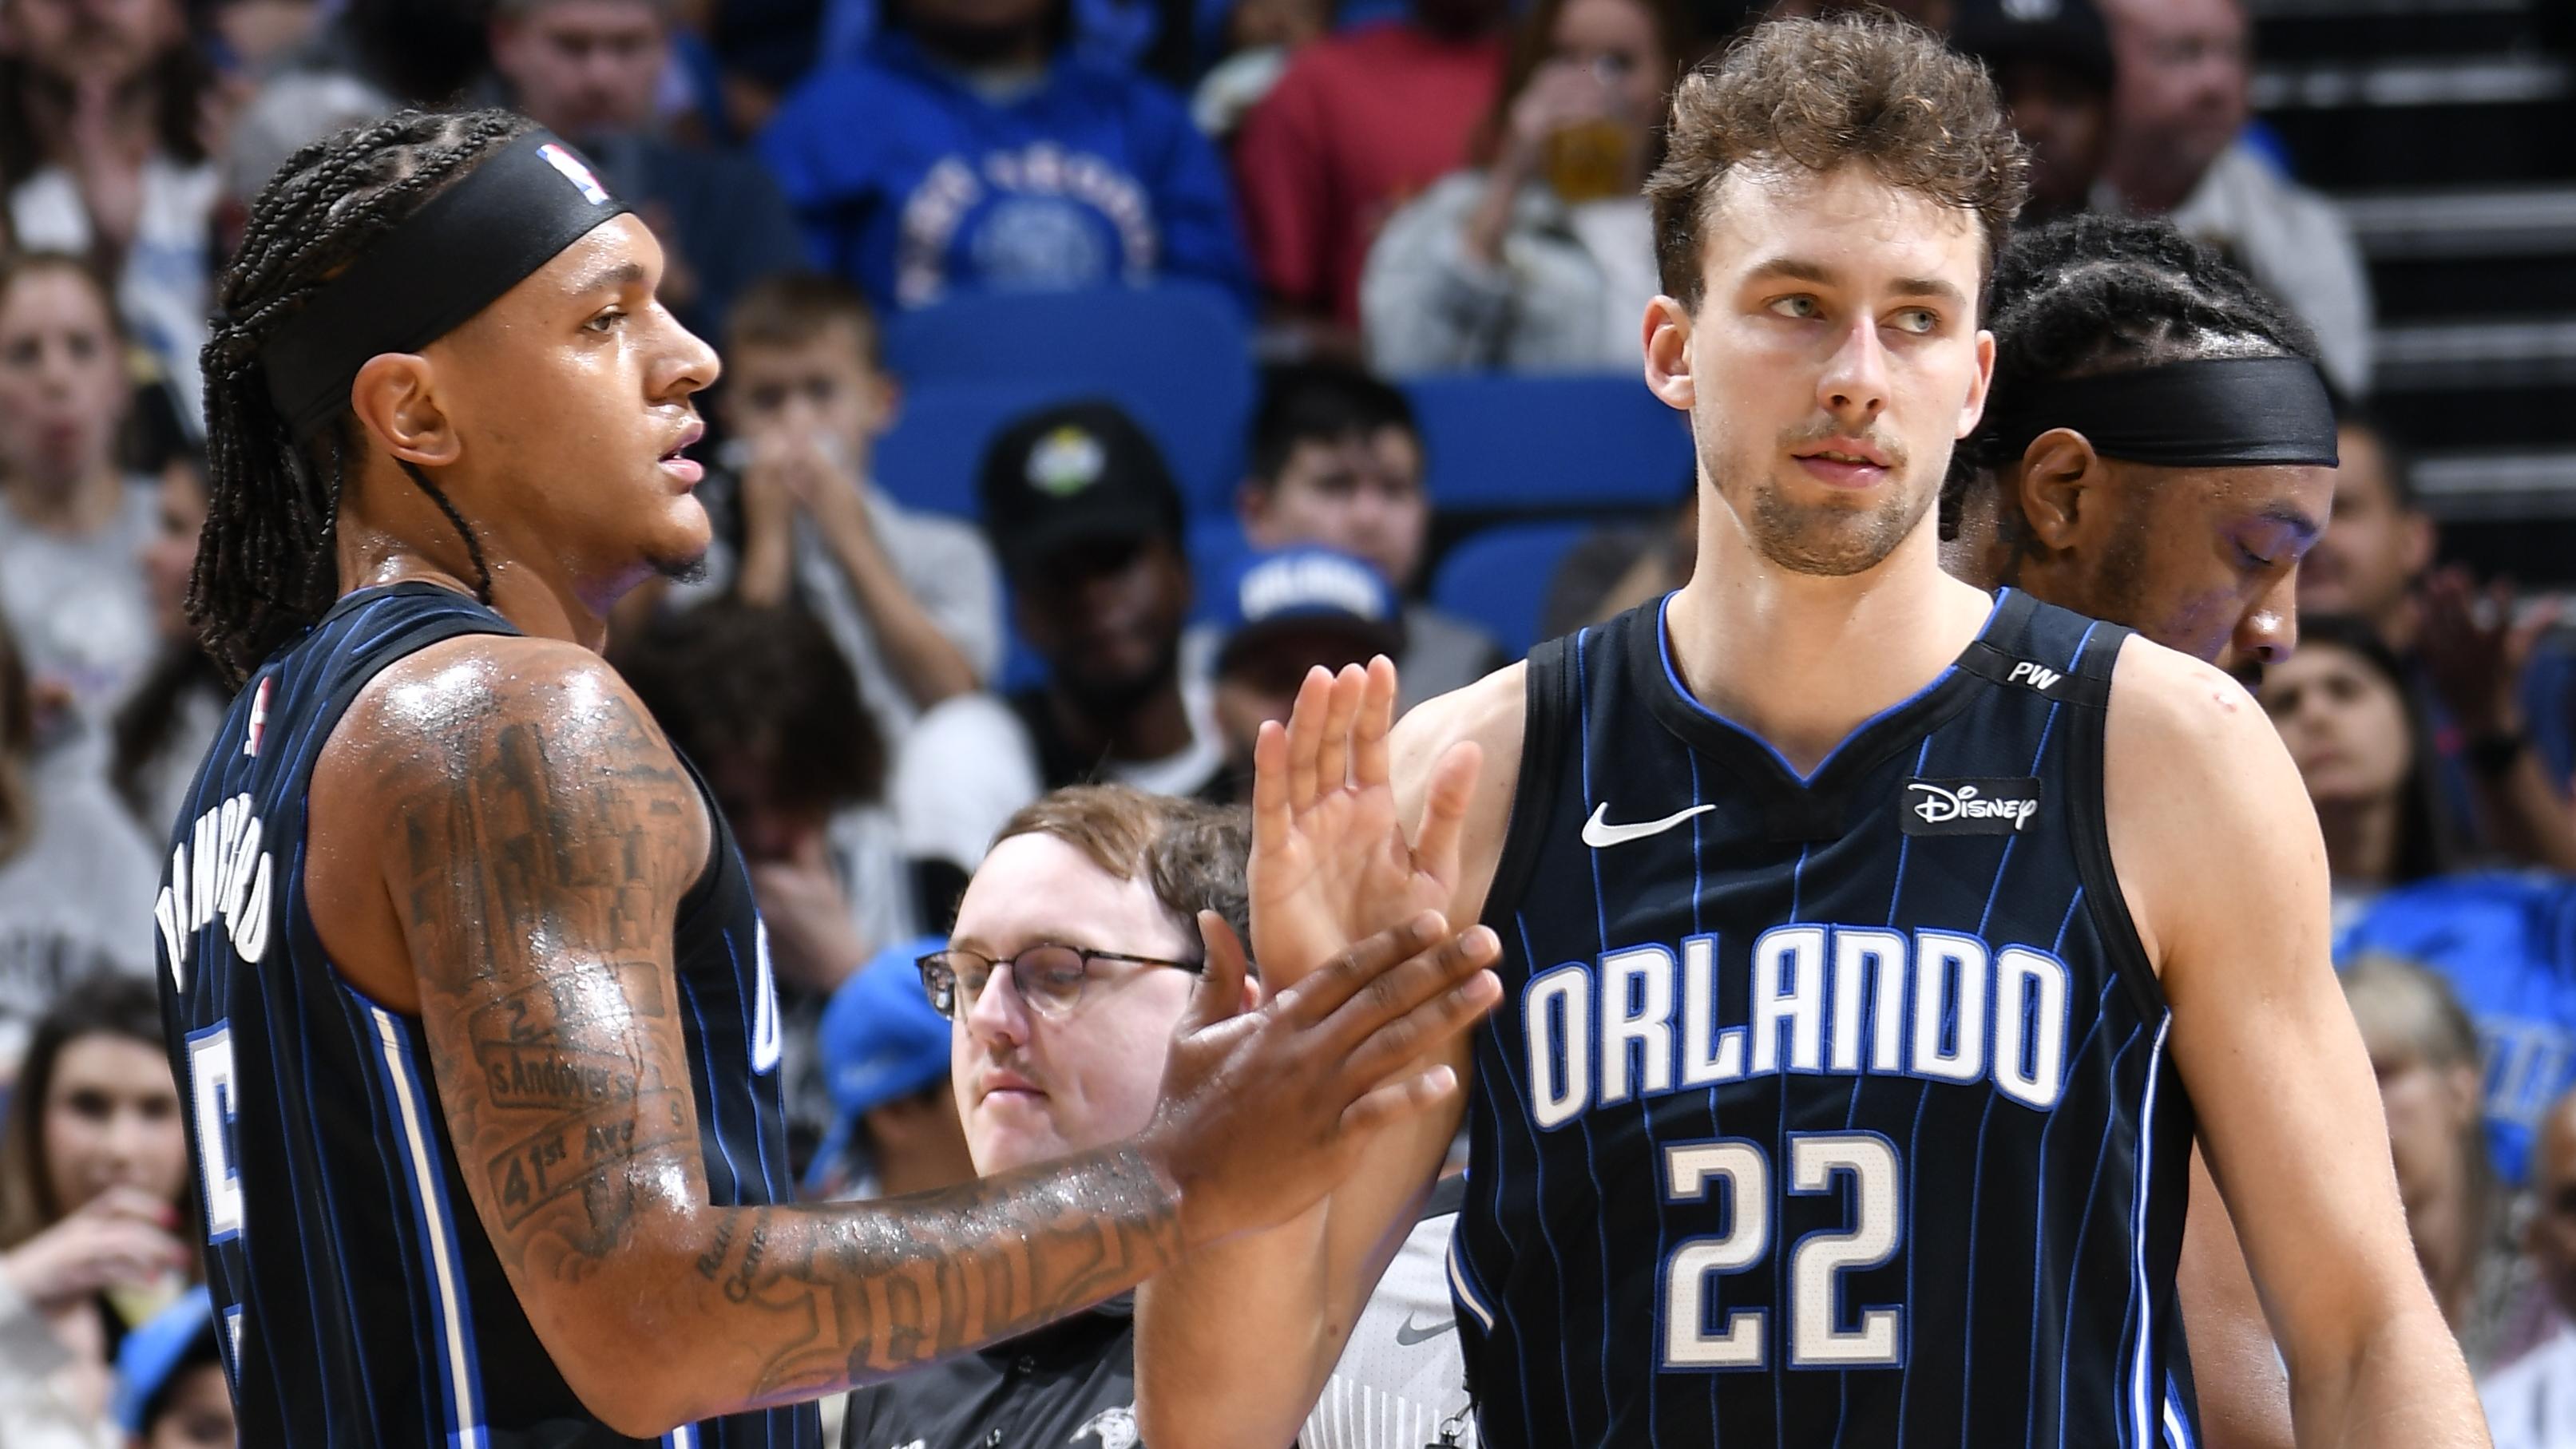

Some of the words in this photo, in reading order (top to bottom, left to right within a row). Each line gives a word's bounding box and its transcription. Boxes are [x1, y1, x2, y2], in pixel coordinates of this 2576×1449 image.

[2007, 662, 2061, 690] PW
[1522, 923, 2070, 1131] ORLANDO
[1658, 1129, 1904, 1372] 22
